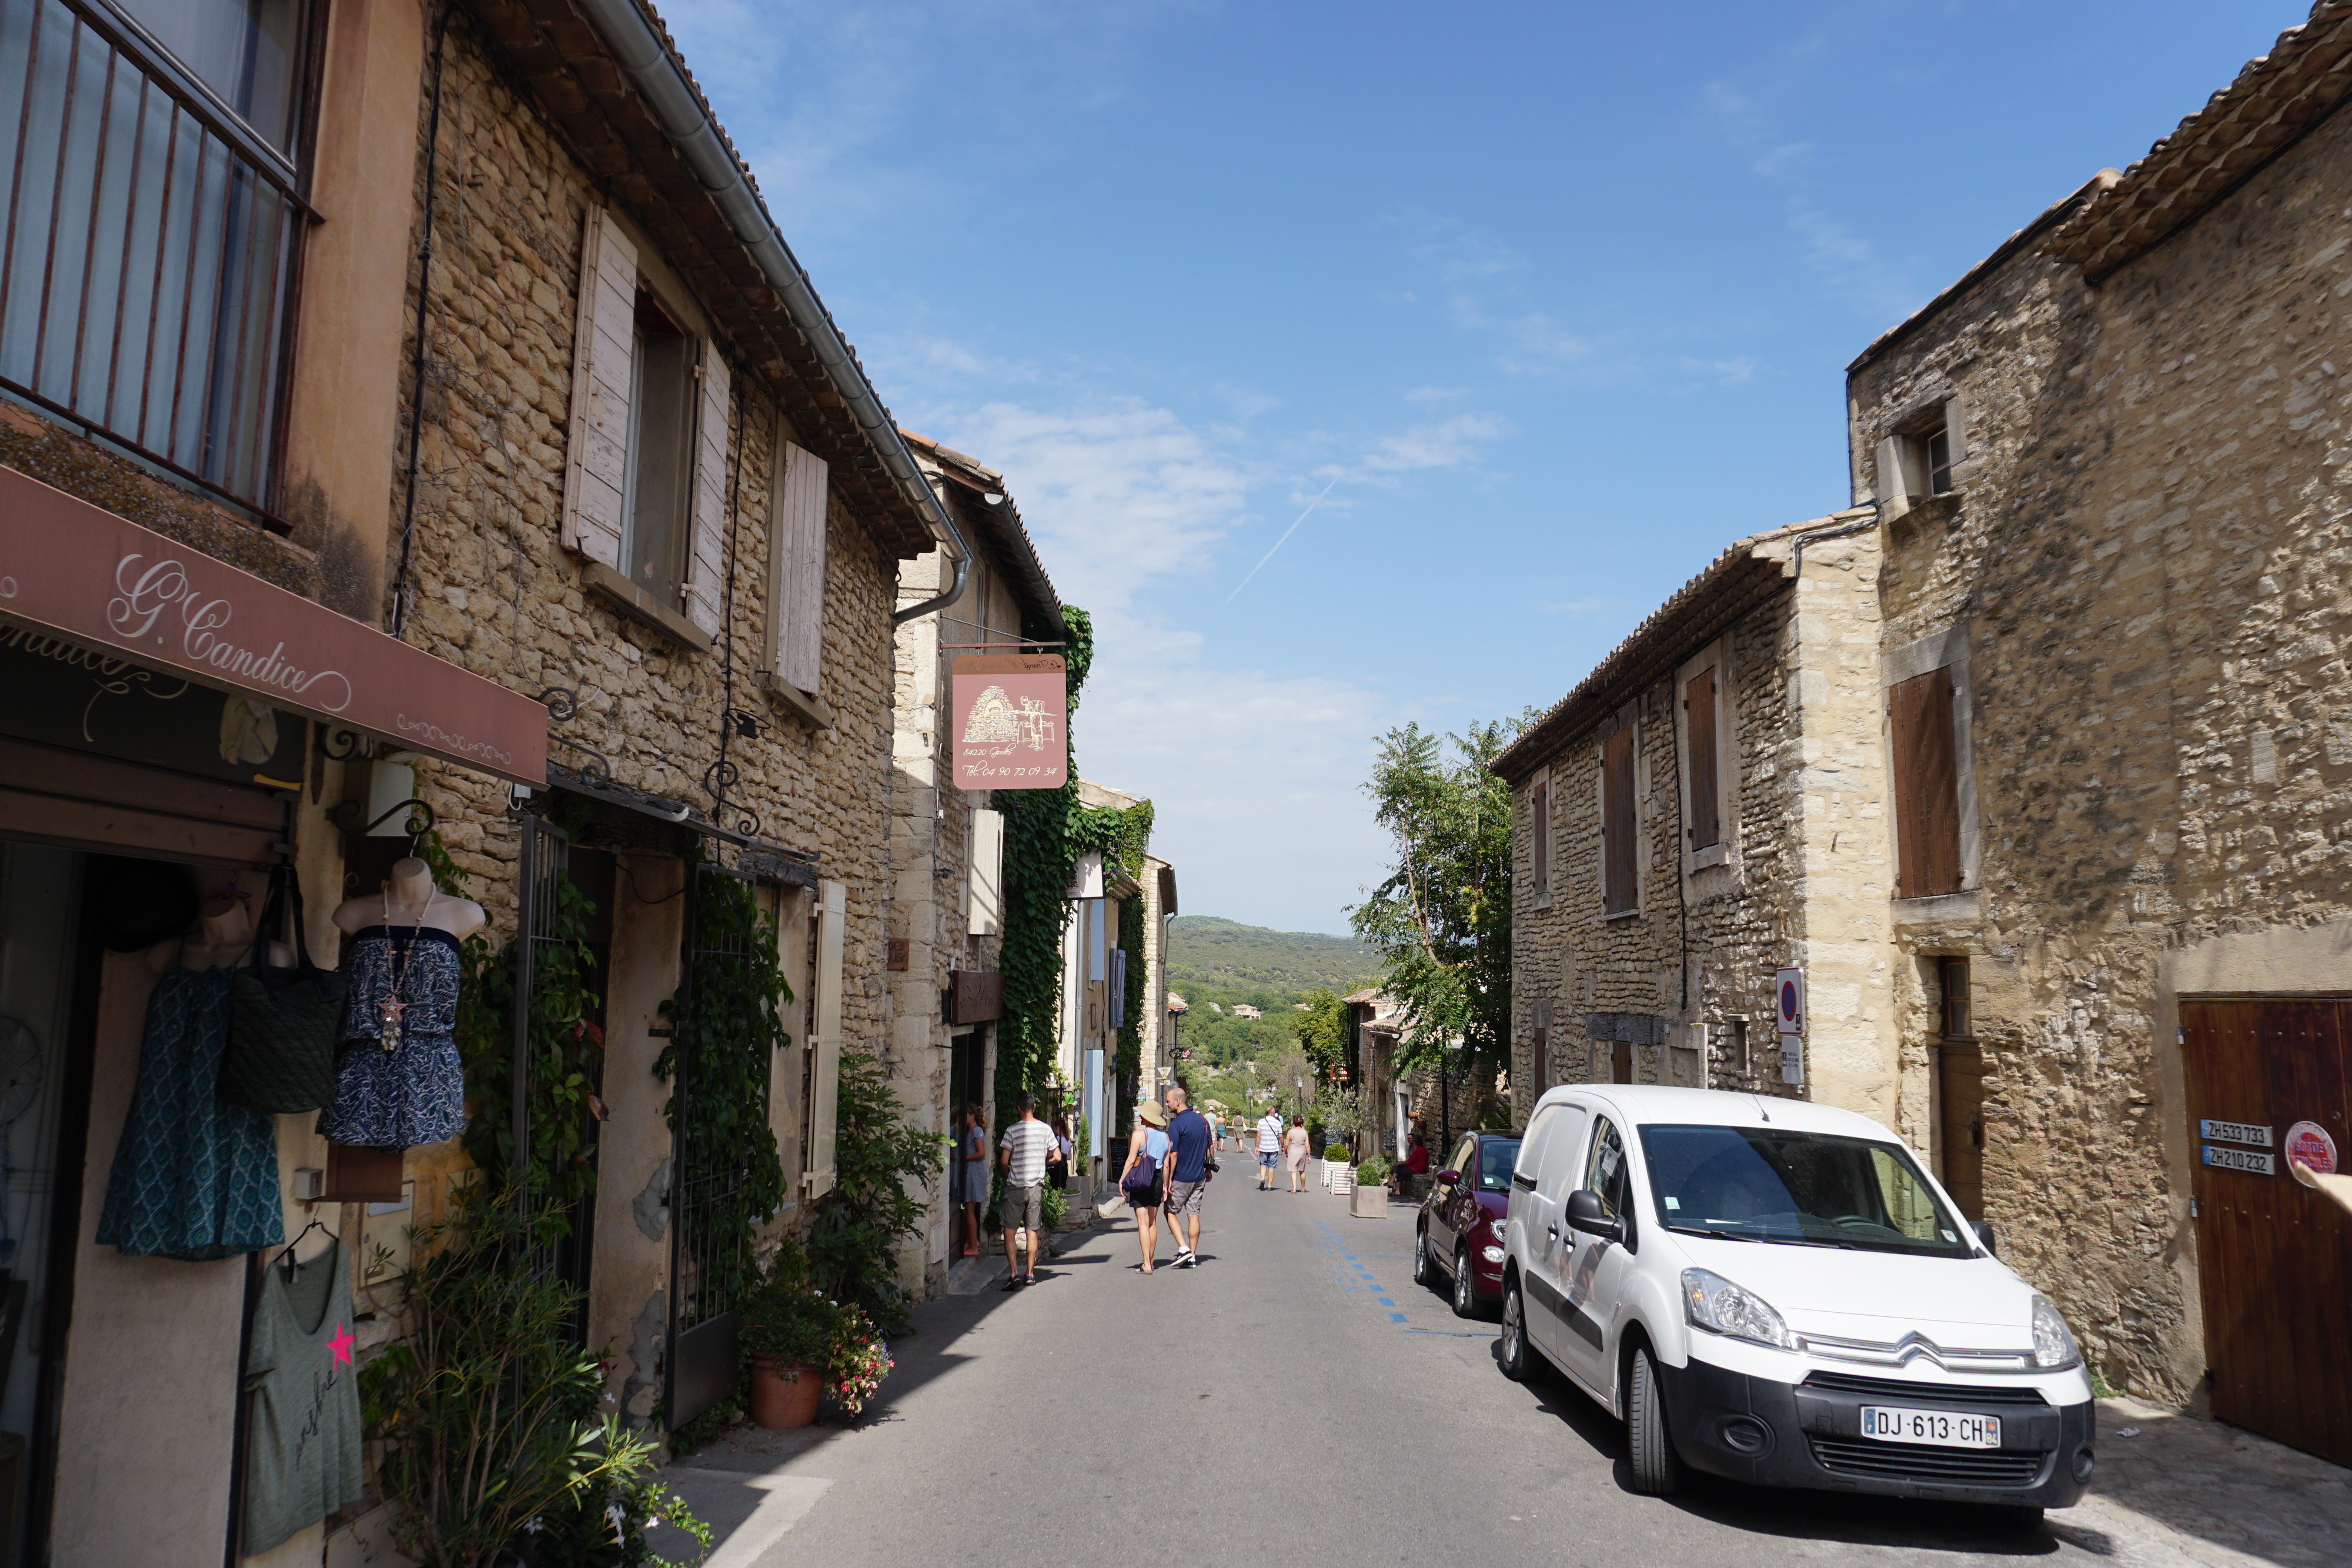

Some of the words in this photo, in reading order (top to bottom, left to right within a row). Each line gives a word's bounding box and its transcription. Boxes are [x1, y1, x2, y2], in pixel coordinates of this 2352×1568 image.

[108, 554, 188, 644] G.
[182, 592, 351, 711] Candice
[990, 743, 1016, 758] Gordes
[983, 768, 995, 776] 04
[998, 767, 1011, 775] 90
[1014, 768, 1025, 776] 72
[1028, 767, 1040, 775] 09
[1044, 767, 1057, 776] 34
[888, 941, 904, 951] DES
[2244, 1126, 2264, 1143] 733
[2294, 1141, 2324, 1153] SORTIE
[2246, 1154, 2267, 1171] 232
[1987, 1433, 1998, 1445] 84
